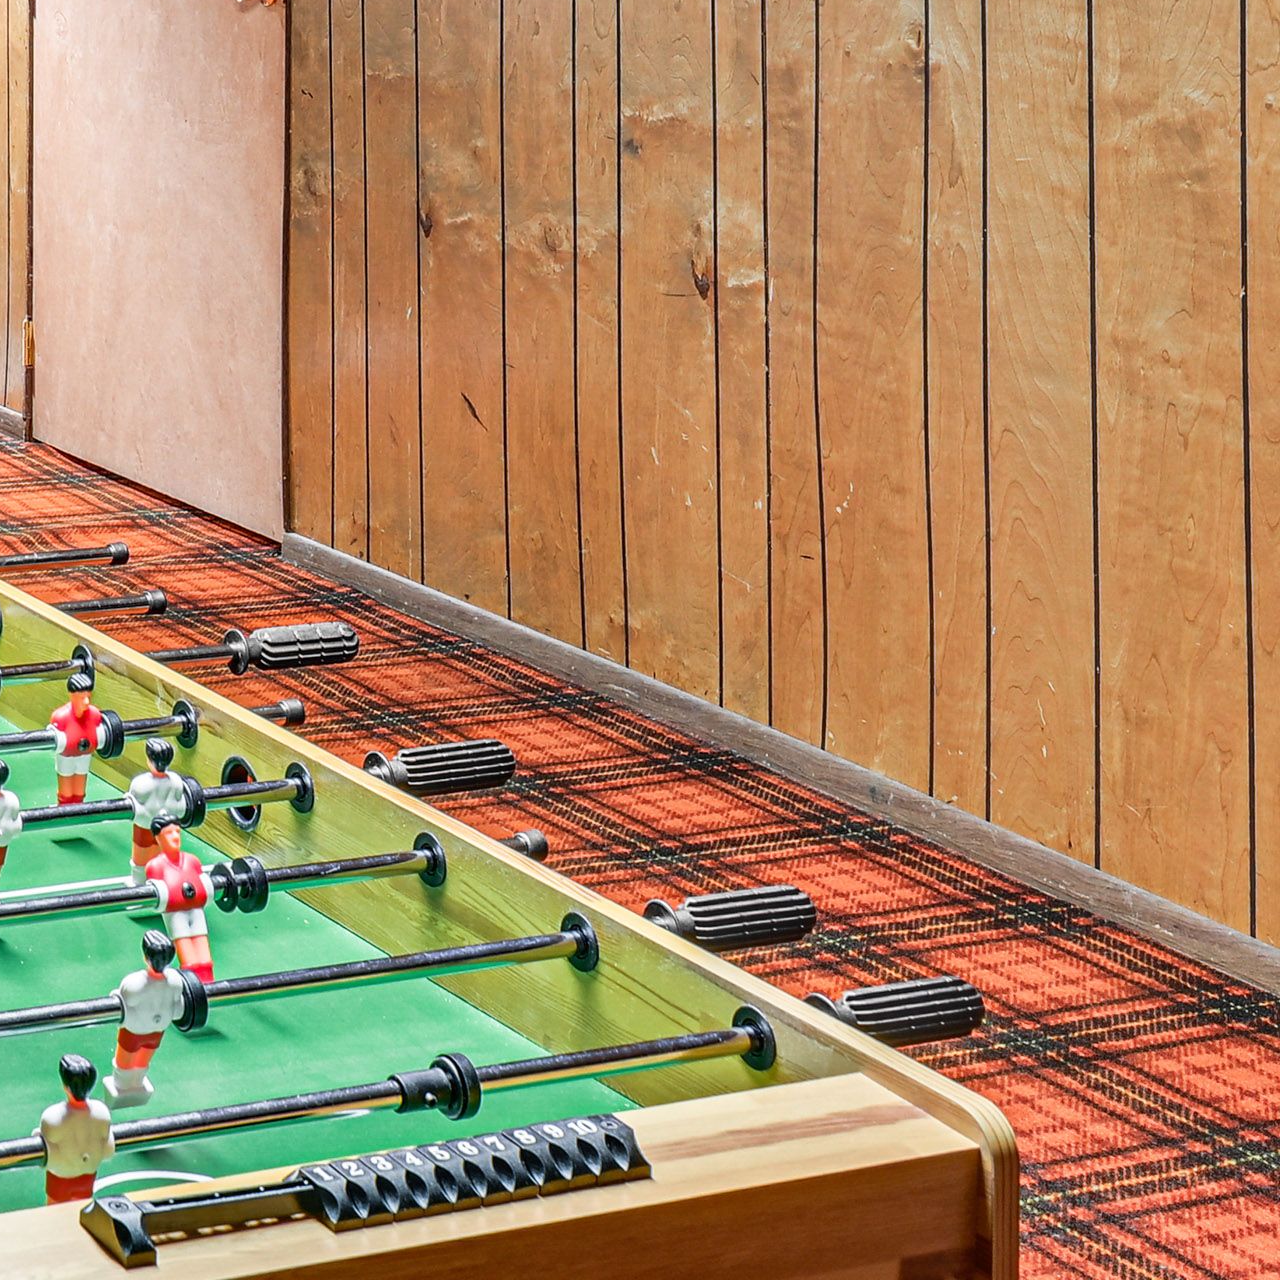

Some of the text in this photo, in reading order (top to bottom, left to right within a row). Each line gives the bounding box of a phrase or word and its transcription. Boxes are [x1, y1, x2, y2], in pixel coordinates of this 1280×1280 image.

[313, 1119, 598, 1181] 1 2 3 4 5 6 7 8 9 10
